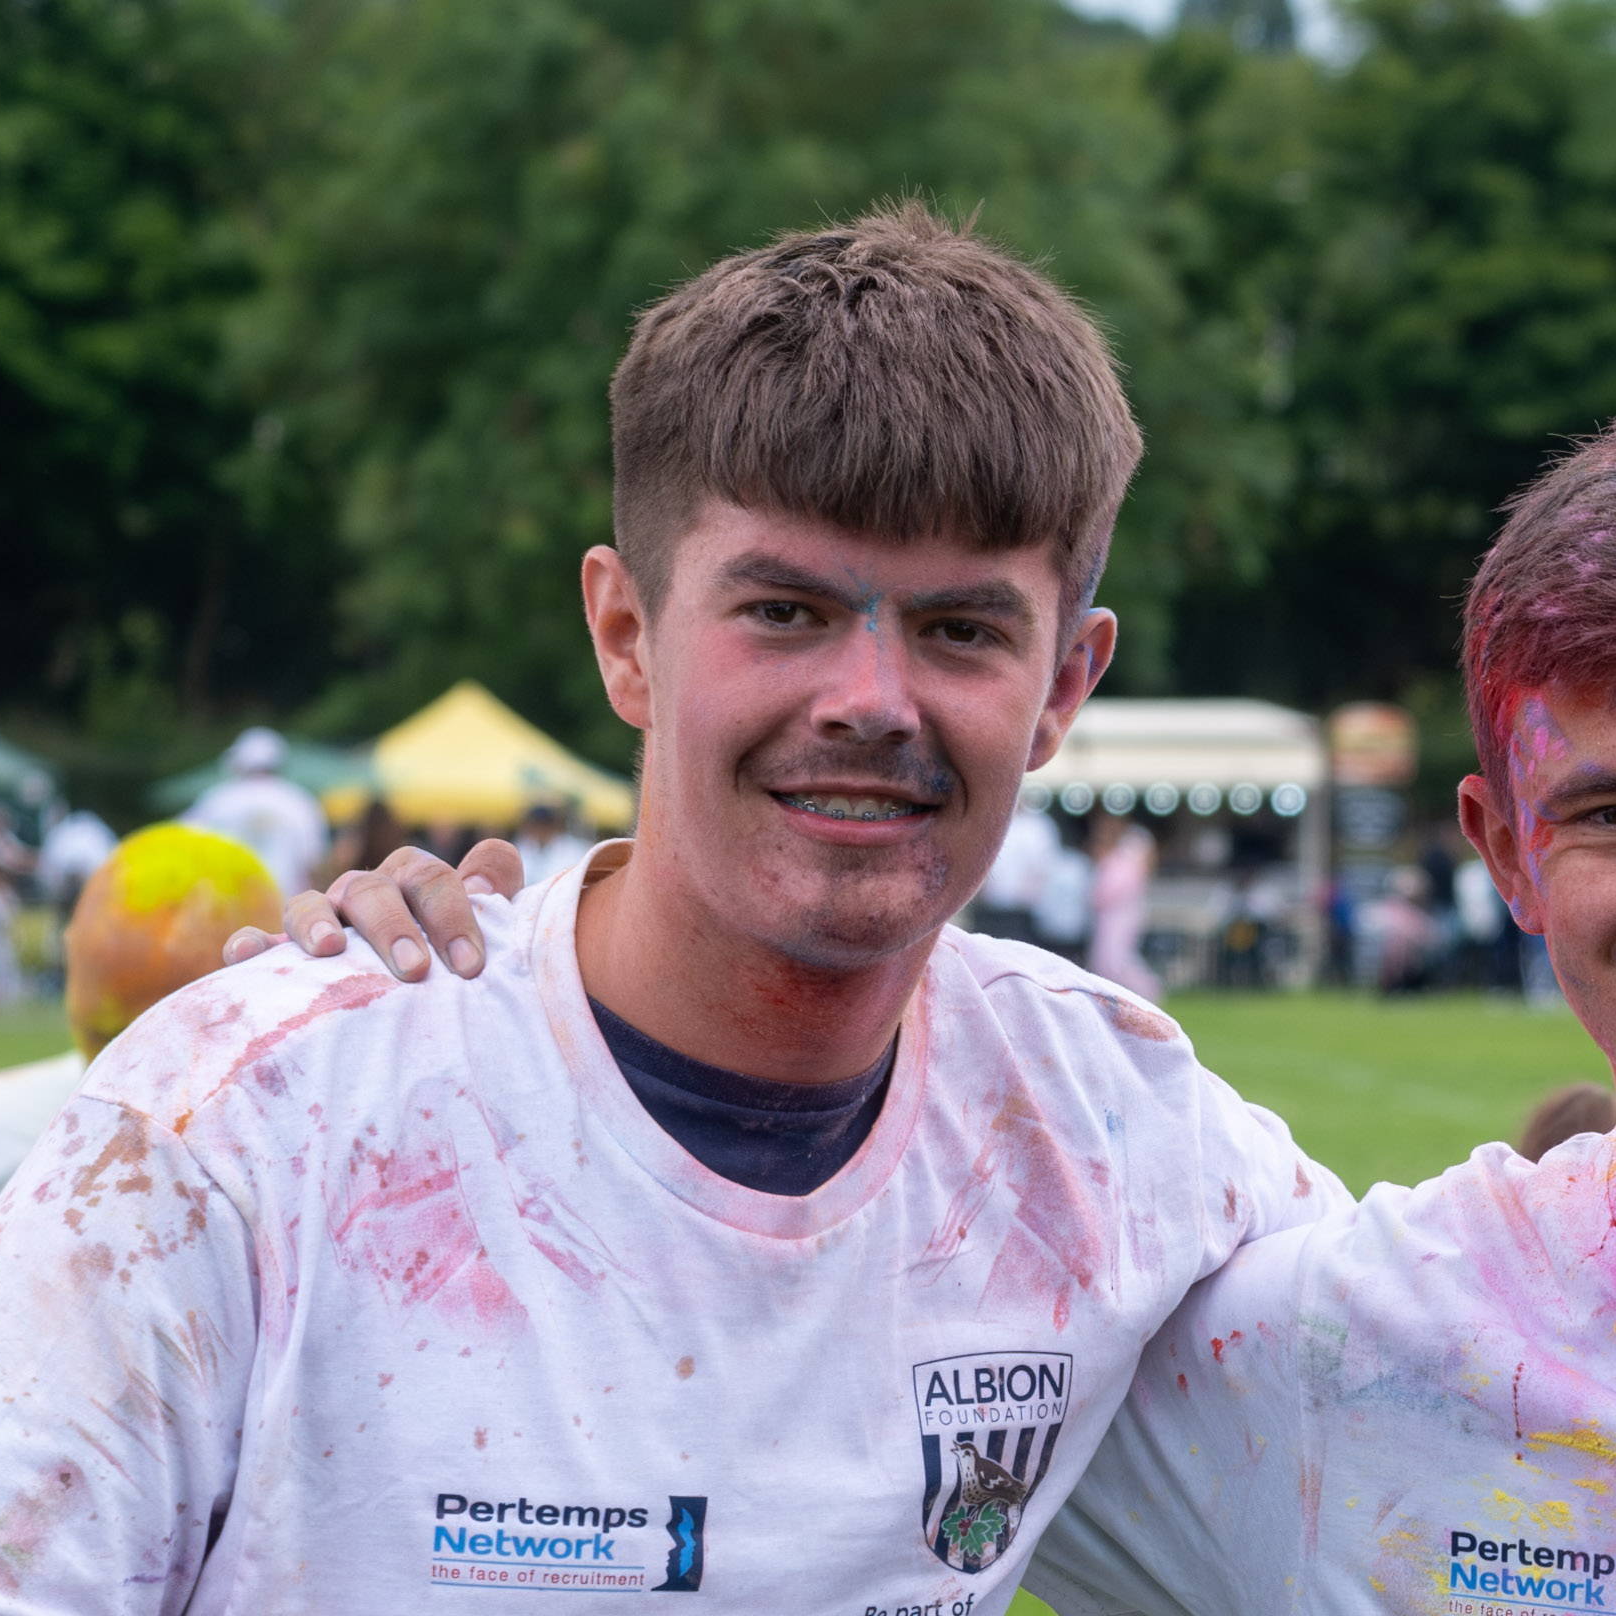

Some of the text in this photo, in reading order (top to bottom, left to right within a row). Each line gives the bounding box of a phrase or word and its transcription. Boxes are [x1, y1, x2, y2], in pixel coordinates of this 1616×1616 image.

[925, 1363, 1065, 1407] ALBION
[925, 1402, 1063, 1427] FOUNDATION
[436, 1493, 649, 1533] Pertemps
[432, 1525, 616, 1561] Network
[431, 1565, 645, 1586] the face of recruitment
[1449, 1562, 1606, 1606] Network
[1448, 1600, 1474, 1615] the
